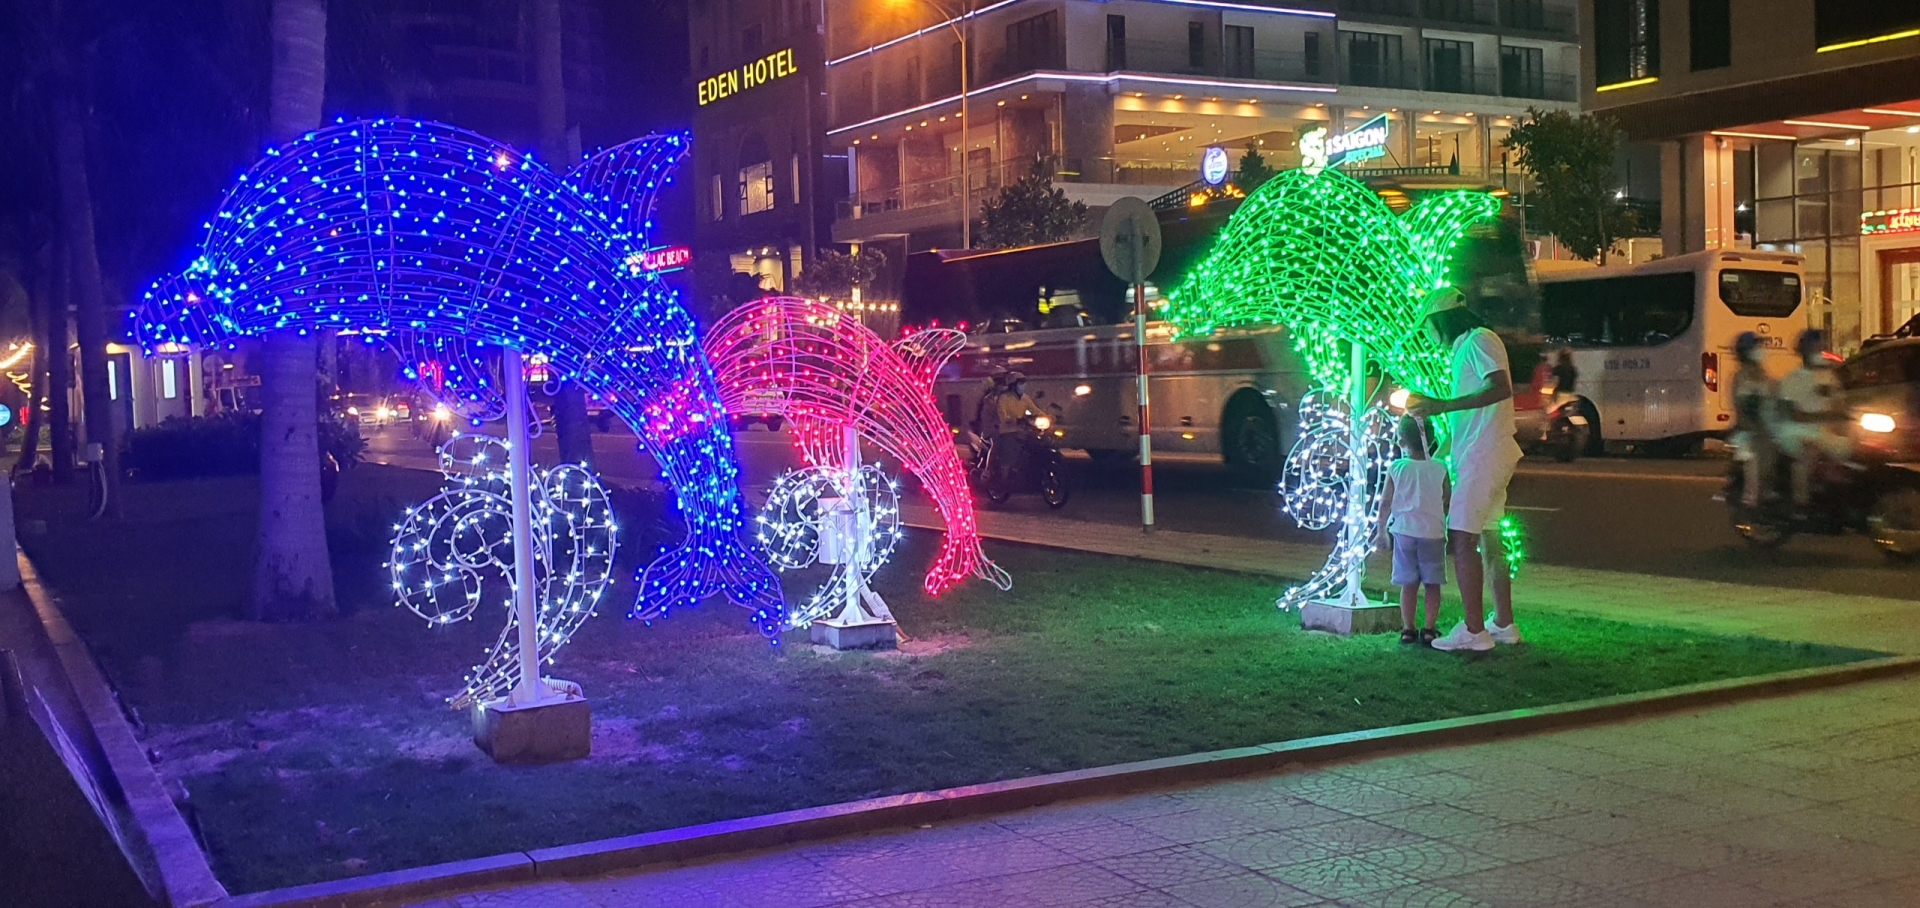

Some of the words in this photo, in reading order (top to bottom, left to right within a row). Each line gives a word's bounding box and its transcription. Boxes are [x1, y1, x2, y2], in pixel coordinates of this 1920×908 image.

[698, 69, 738, 106] EDEN
[743, 48, 798, 90] HOTEL
[1332, 126, 1386, 154] SAIGON
